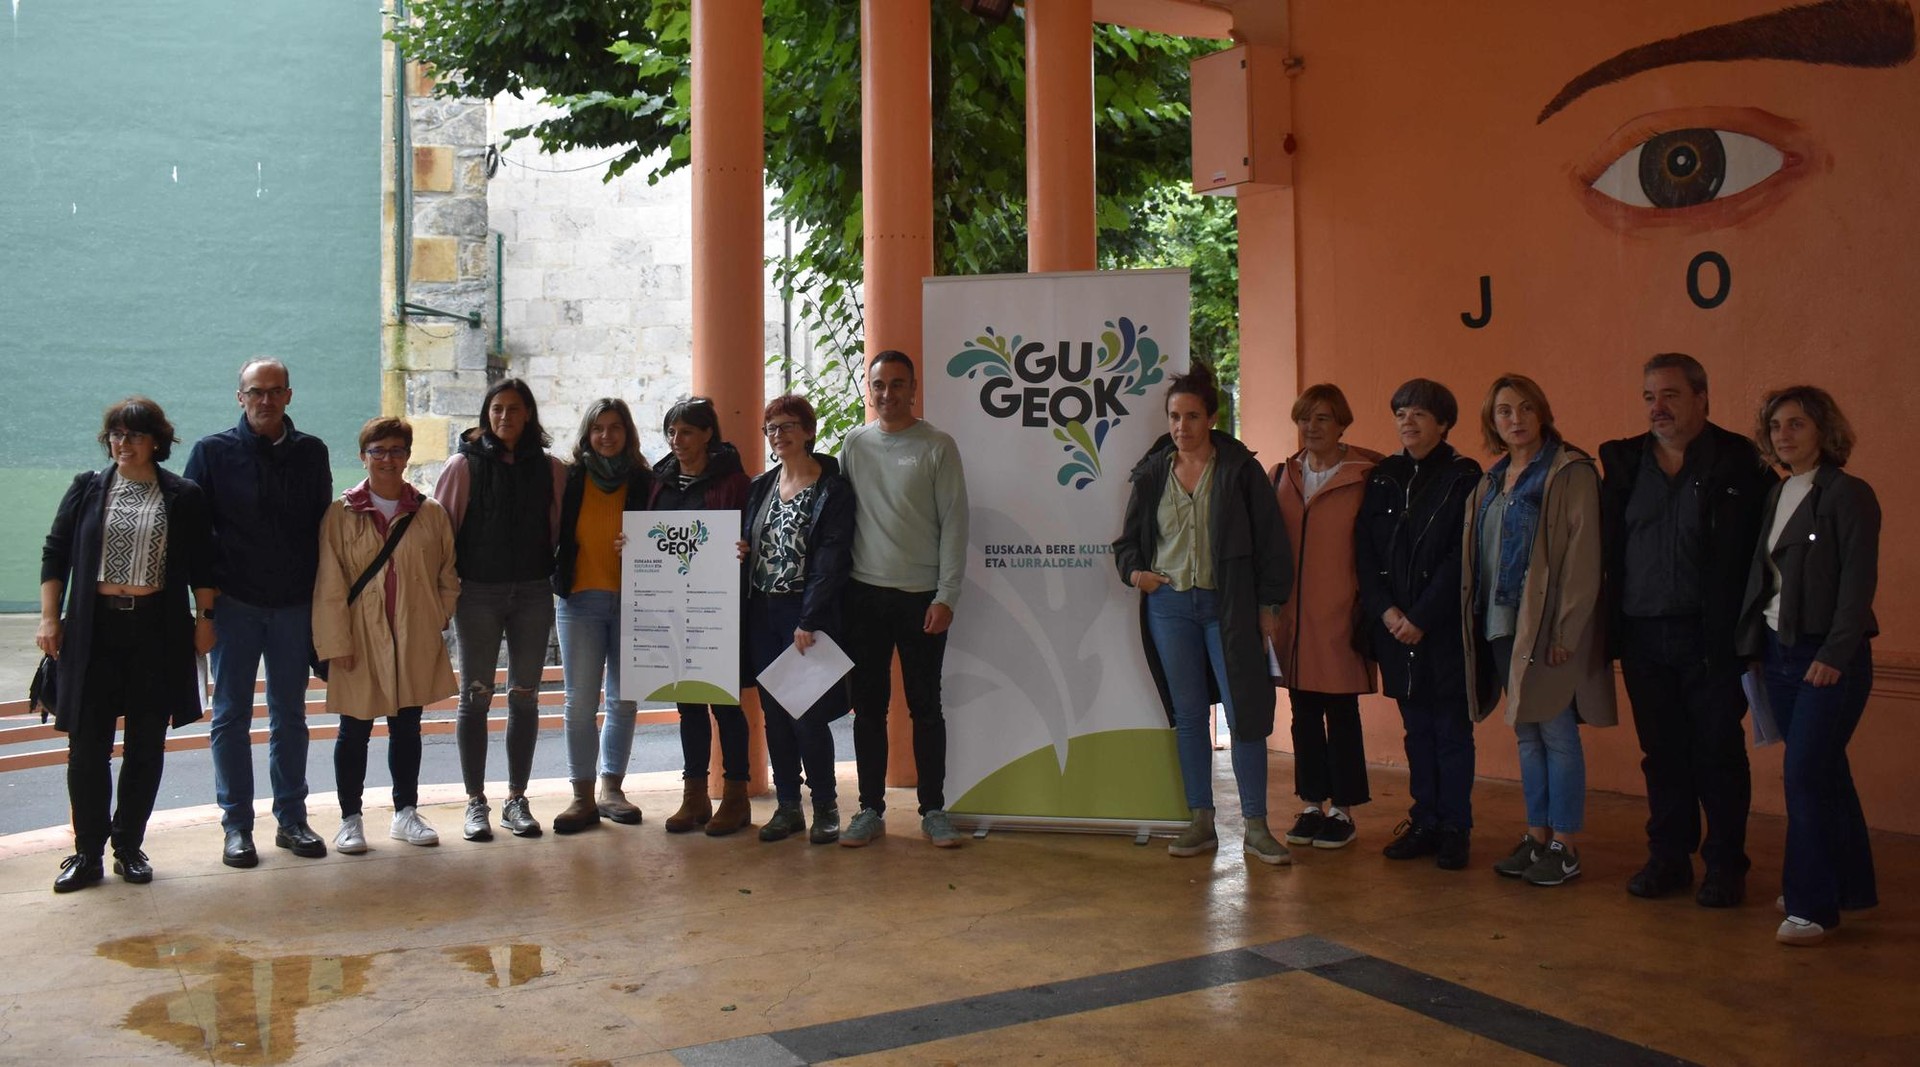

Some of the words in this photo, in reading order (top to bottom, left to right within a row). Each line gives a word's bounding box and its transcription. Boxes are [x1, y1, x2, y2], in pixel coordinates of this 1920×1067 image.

[1460, 275, 1492, 329] J
[1014, 341, 1093, 384] GU
[979, 375, 1130, 428] GEOK
[666, 527, 689, 541] GU
[656, 538, 699, 555] GEOK
[985, 544, 1042, 555] EUSKARA
[1045, 544, 1076, 555] BERE
[985, 557, 1007, 568] ETA
[1010, 557, 1093, 568] LURRALDEAN
